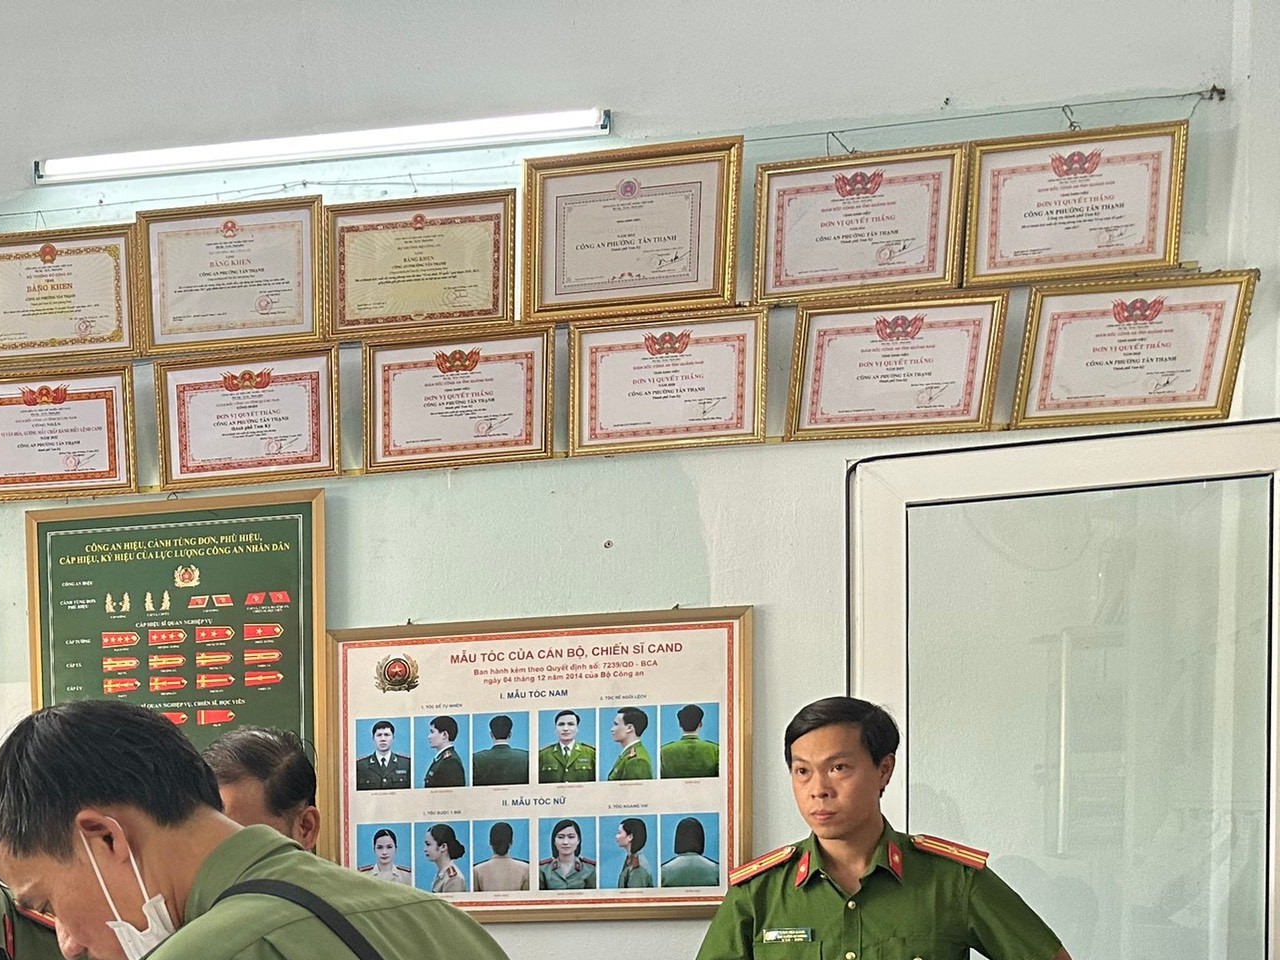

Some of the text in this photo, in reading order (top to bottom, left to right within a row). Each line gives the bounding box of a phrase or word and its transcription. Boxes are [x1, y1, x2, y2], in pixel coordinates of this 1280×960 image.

[50, 283, 73, 291] KHEN
[77, 554, 100, 565] HIỆU,
[115, 552, 135, 562] HIỆU
[136, 548, 154, 560] CỦA
[206, 545, 231, 556] CÔNG
[232, 545, 244, 554] AN
[246, 543, 270, 553] NHÂN
[272, 541, 290, 551] DÂN
[85, 542, 109, 552] CÔNG
[110, 543, 122, 551] AN
[123, 541, 147, 552] HIỆU,
[450, 642, 683, 664] MẪU TÓC CỦA CÁN BỘ, CHIẾN SĨ CAND
[473, 668, 488, 676] Ban
[490, 667, 509, 675] hành
[510, 666, 526, 674] kèm
[527, 665, 544, 673] theo
[546, 664, 568, 674] Quyết
[570, 663, 587, 671] định
[640, 659, 658, 667] BCA
[483, 677, 501, 686] ngày
[513, 674, 535, 684] tháng
[548, 673, 564, 681] năm
[584, 671, 599, 679] của
[600, 670, 611, 678] Bộ
[612, 669, 633, 678] Công
[507, 689, 527, 699] MẪU
[528, 689, 548, 698] TÓC
[550, 689, 568, 697] NAM
[511, 796, 531, 806] MẪU
[533, 796, 551, 805] TÓC
[553, 796, 567, 805] NỮ
